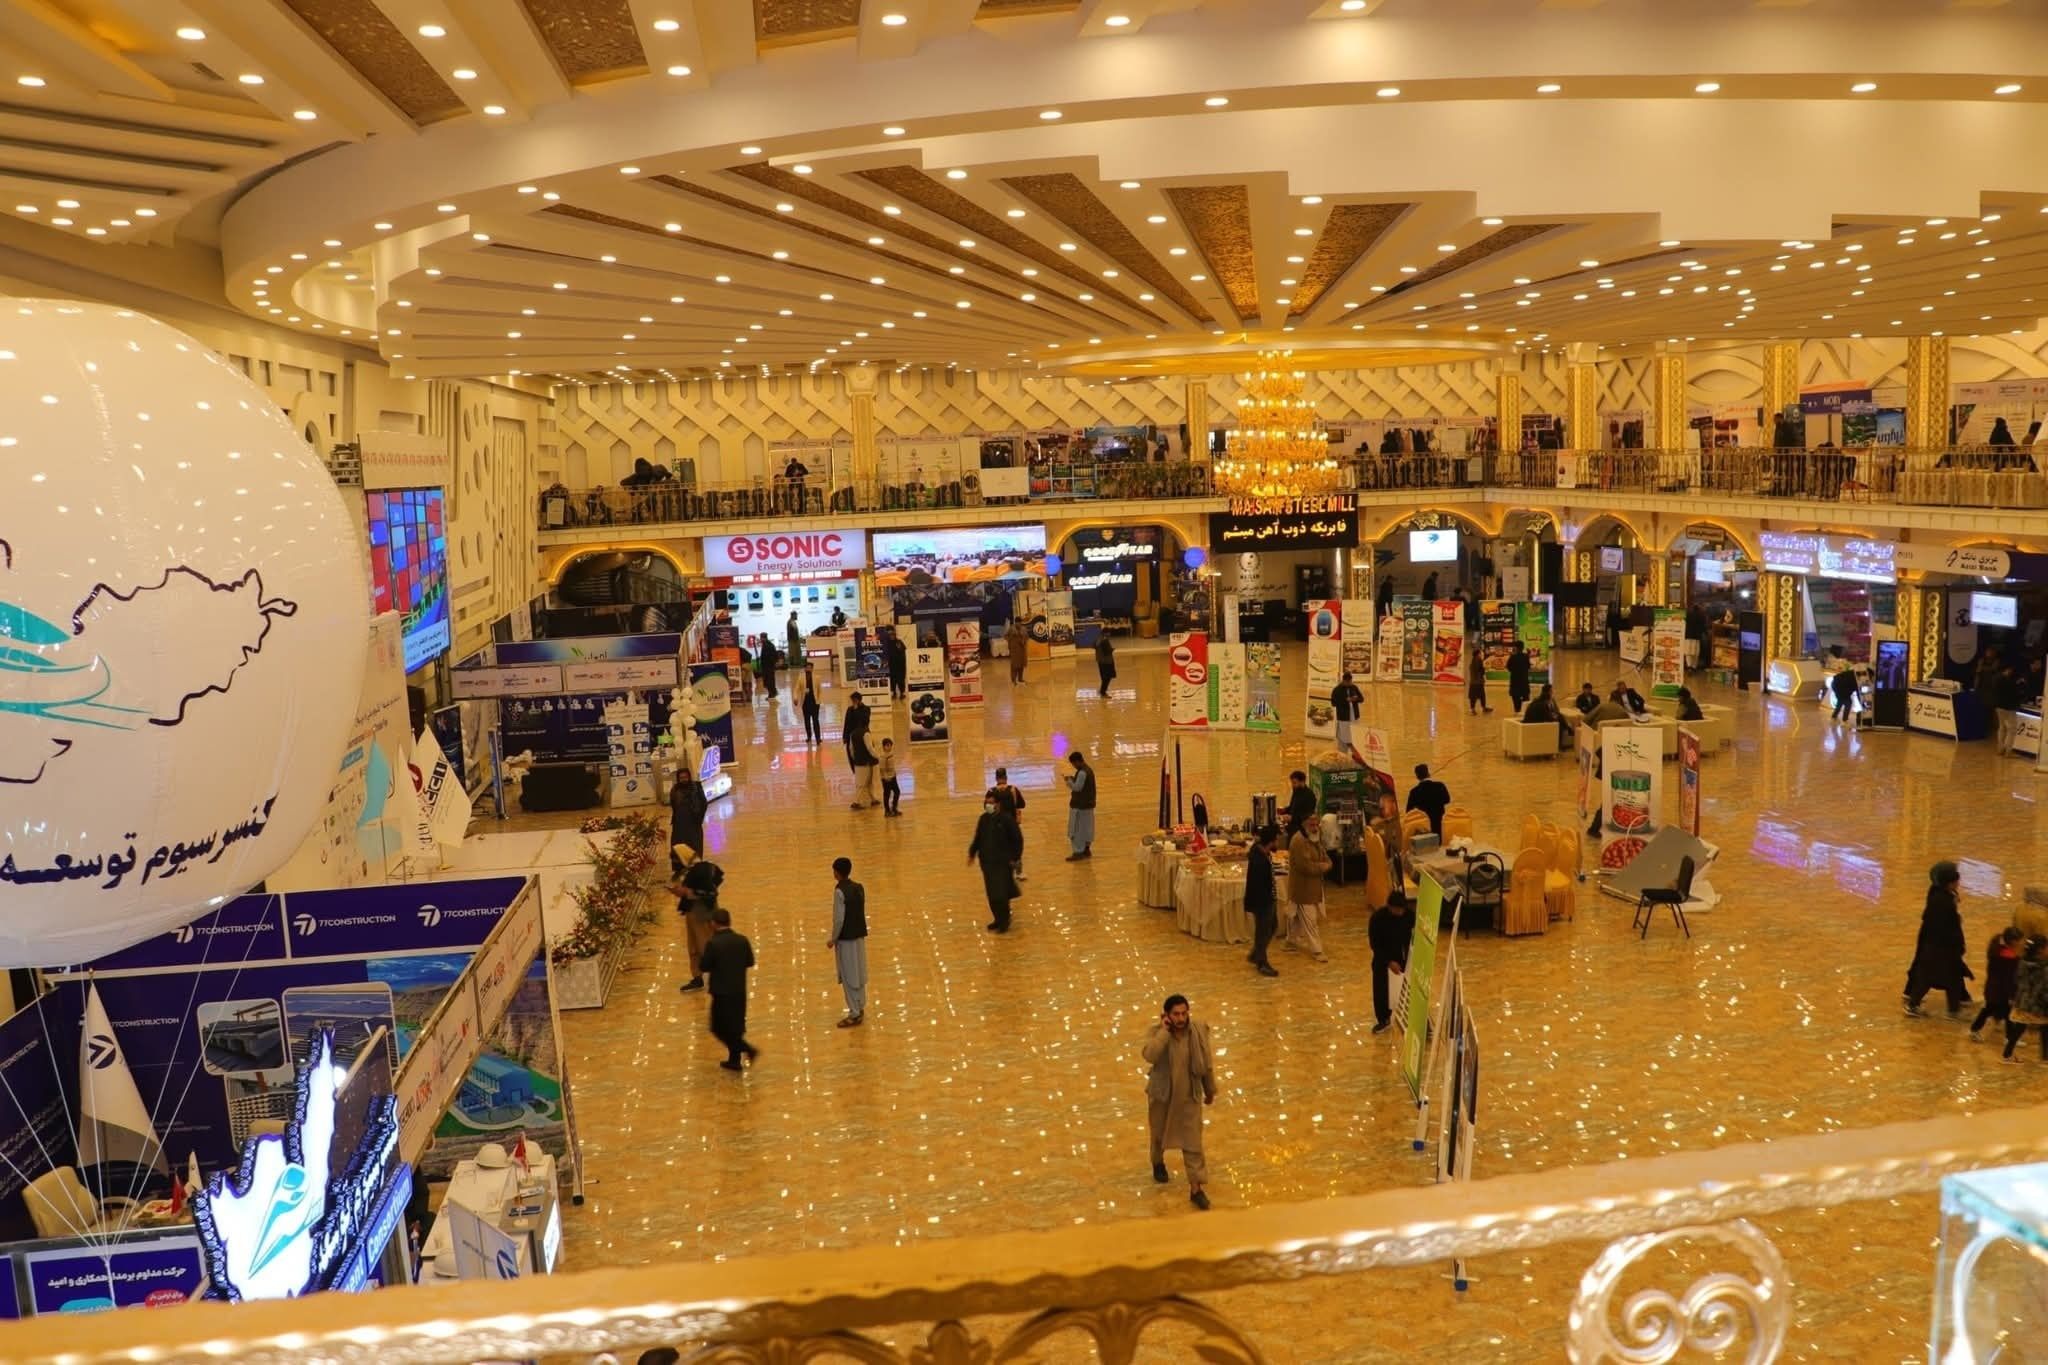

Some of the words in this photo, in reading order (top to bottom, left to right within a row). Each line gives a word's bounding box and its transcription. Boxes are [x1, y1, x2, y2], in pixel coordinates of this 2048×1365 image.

[1327, 495, 1356, 513] MILL
[1256, 519, 1279, 540] آهن
[1281, 522, 1307, 538] ذوب
[756, 534, 842, 560] SONIC
[1083, 544, 1154, 558] GOODYEAR
[757, 561, 793, 573] Energy
[797, 558, 842, 570] Solutions
[1069, 572, 1132, 586] GOODYEAR
[196, 922, 274, 936] 77CONSTRUCTION
[319, 914, 396, 929] 77CONSTRUCTION
